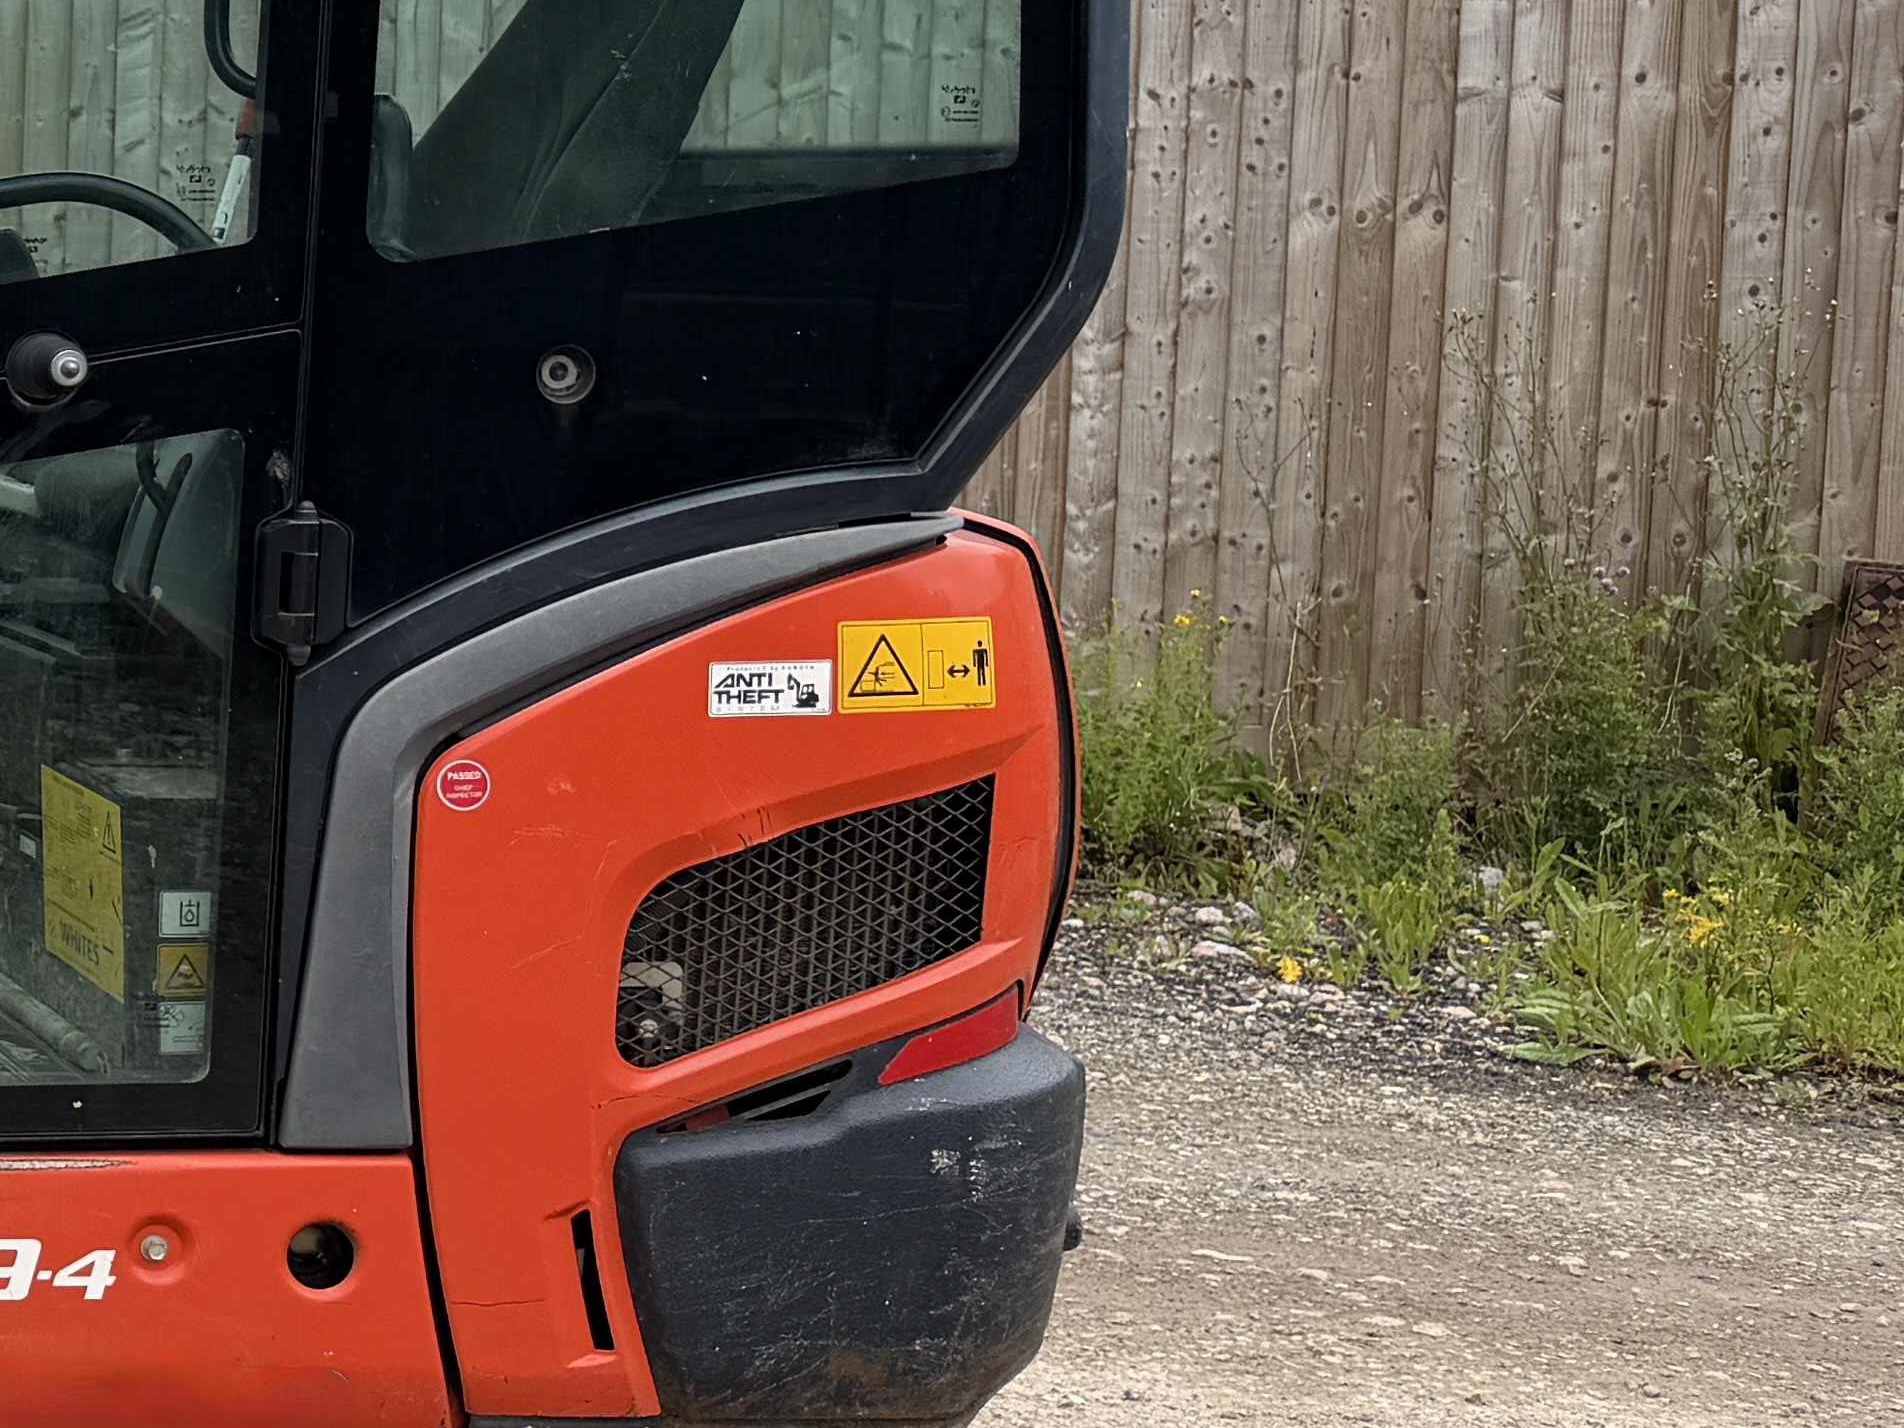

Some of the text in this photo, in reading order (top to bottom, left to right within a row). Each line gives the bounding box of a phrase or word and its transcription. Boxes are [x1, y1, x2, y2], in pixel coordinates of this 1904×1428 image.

[713, 672, 773, 689] ANTI
[713, 689, 785, 704] THEFT
[59, 918, 101, 966] WHITES
